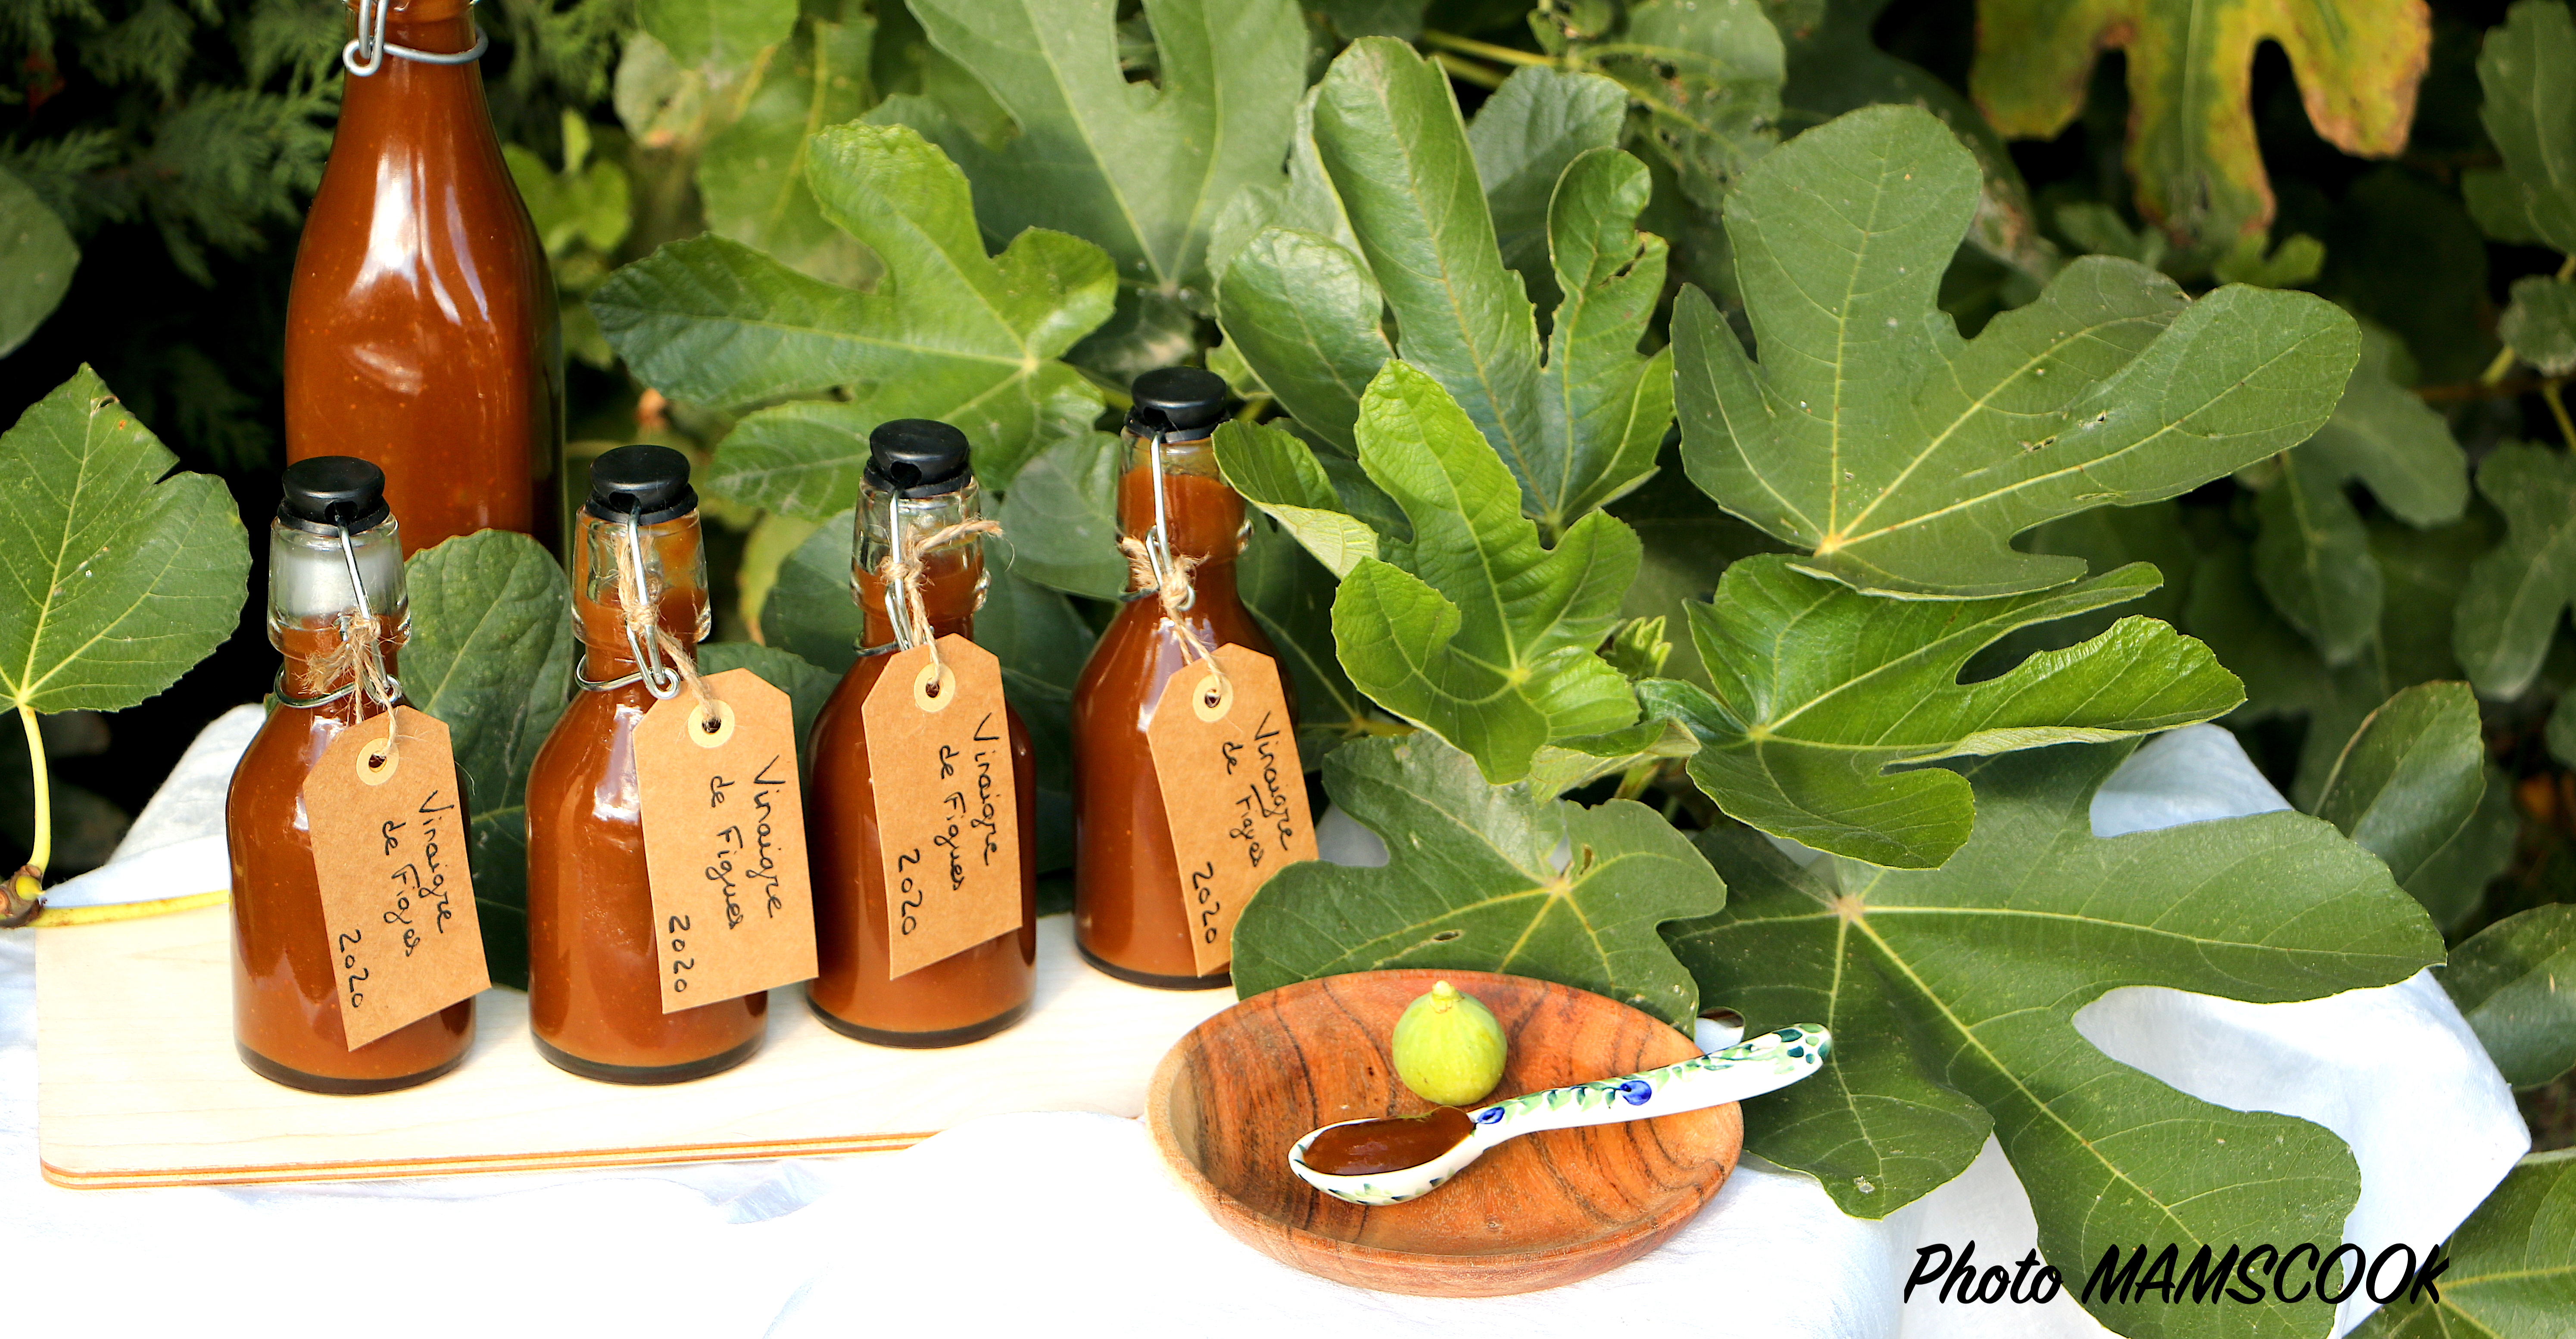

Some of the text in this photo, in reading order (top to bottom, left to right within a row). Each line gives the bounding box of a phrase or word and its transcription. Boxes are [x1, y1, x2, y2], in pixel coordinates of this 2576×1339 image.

[971, 712, 999, 865] Vinaigre
[1223, 741, 1243, 775] de
[1254, 711, 1292, 851] Vinaigre
[382, 820, 406, 856] de
[418, 789, 454, 934] Vinaigre
[705, 775, 743, 930] de Figues
[745, 754, 786, 918] Vinaigre
[934, 744, 965, 891] de Figues
[898, 849, 923, 935] 2020
[1192, 862, 1220, 944] 2020
[339, 929, 369, 1008] 2020
[669, 914, 694, 992] 2020
